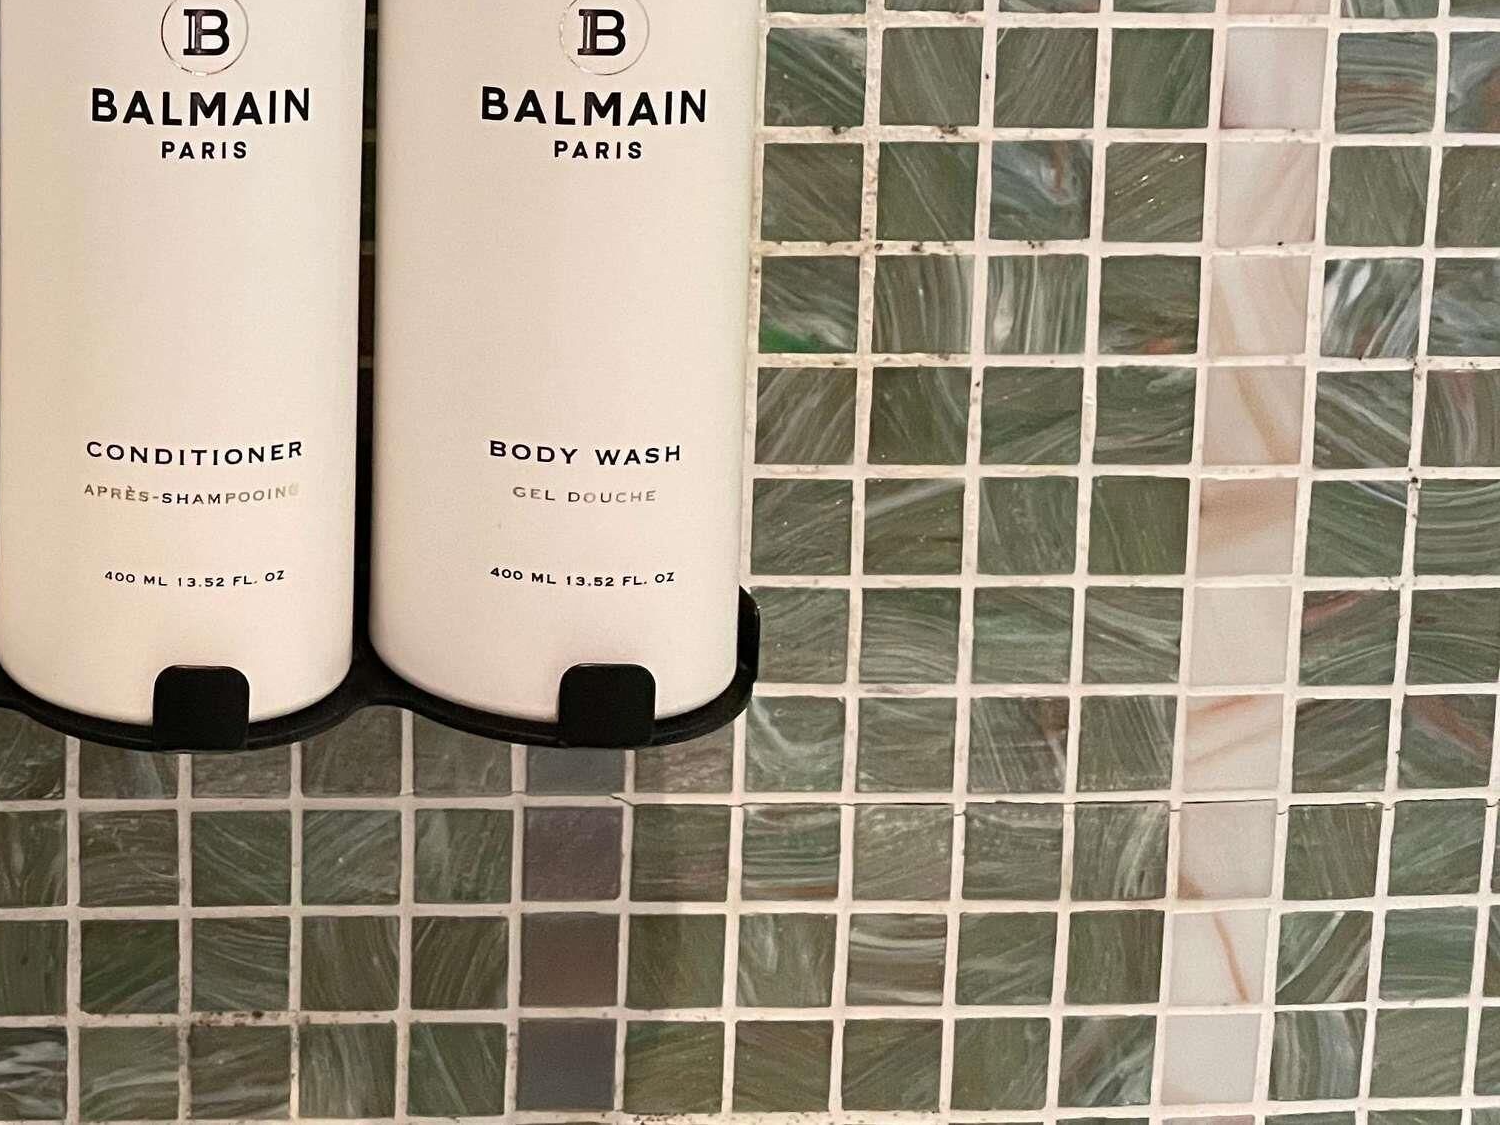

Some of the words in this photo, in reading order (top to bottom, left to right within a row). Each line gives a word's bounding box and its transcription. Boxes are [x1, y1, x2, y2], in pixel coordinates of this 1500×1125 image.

[182, 8, 231, 56] B
[577, 8, 627, 57] B
[91, 87, 310, 127] BALMAIN
[481, 86, 707, 127] BALMAIN
[161, 140, 248, 160] PARIS
[553, 140, 643, 160] PARIS
[86, 441, 303, 466] CONDITIONER
[489, 440, 579, 465] BODY
[594, 444, 681, 466] WASH
[512, 486, 556, 502] GEL
[567, 489, 657, 505] DOUCHE
[104, 570, 136, 584] 400
[143, 575, 168, 587] ML
[177, 577, 225, 588] 13.52
[232, 575, 259, 587] FL.
[264, 569, 285, 582] OZ
[489, 567, 524, 581] 400
[531, 572, 557, 585] ML
[566, 575, 615, 587] 13.52
[622, 575, 648, 586] FL.
[654, 571, 676, 584] OZ
